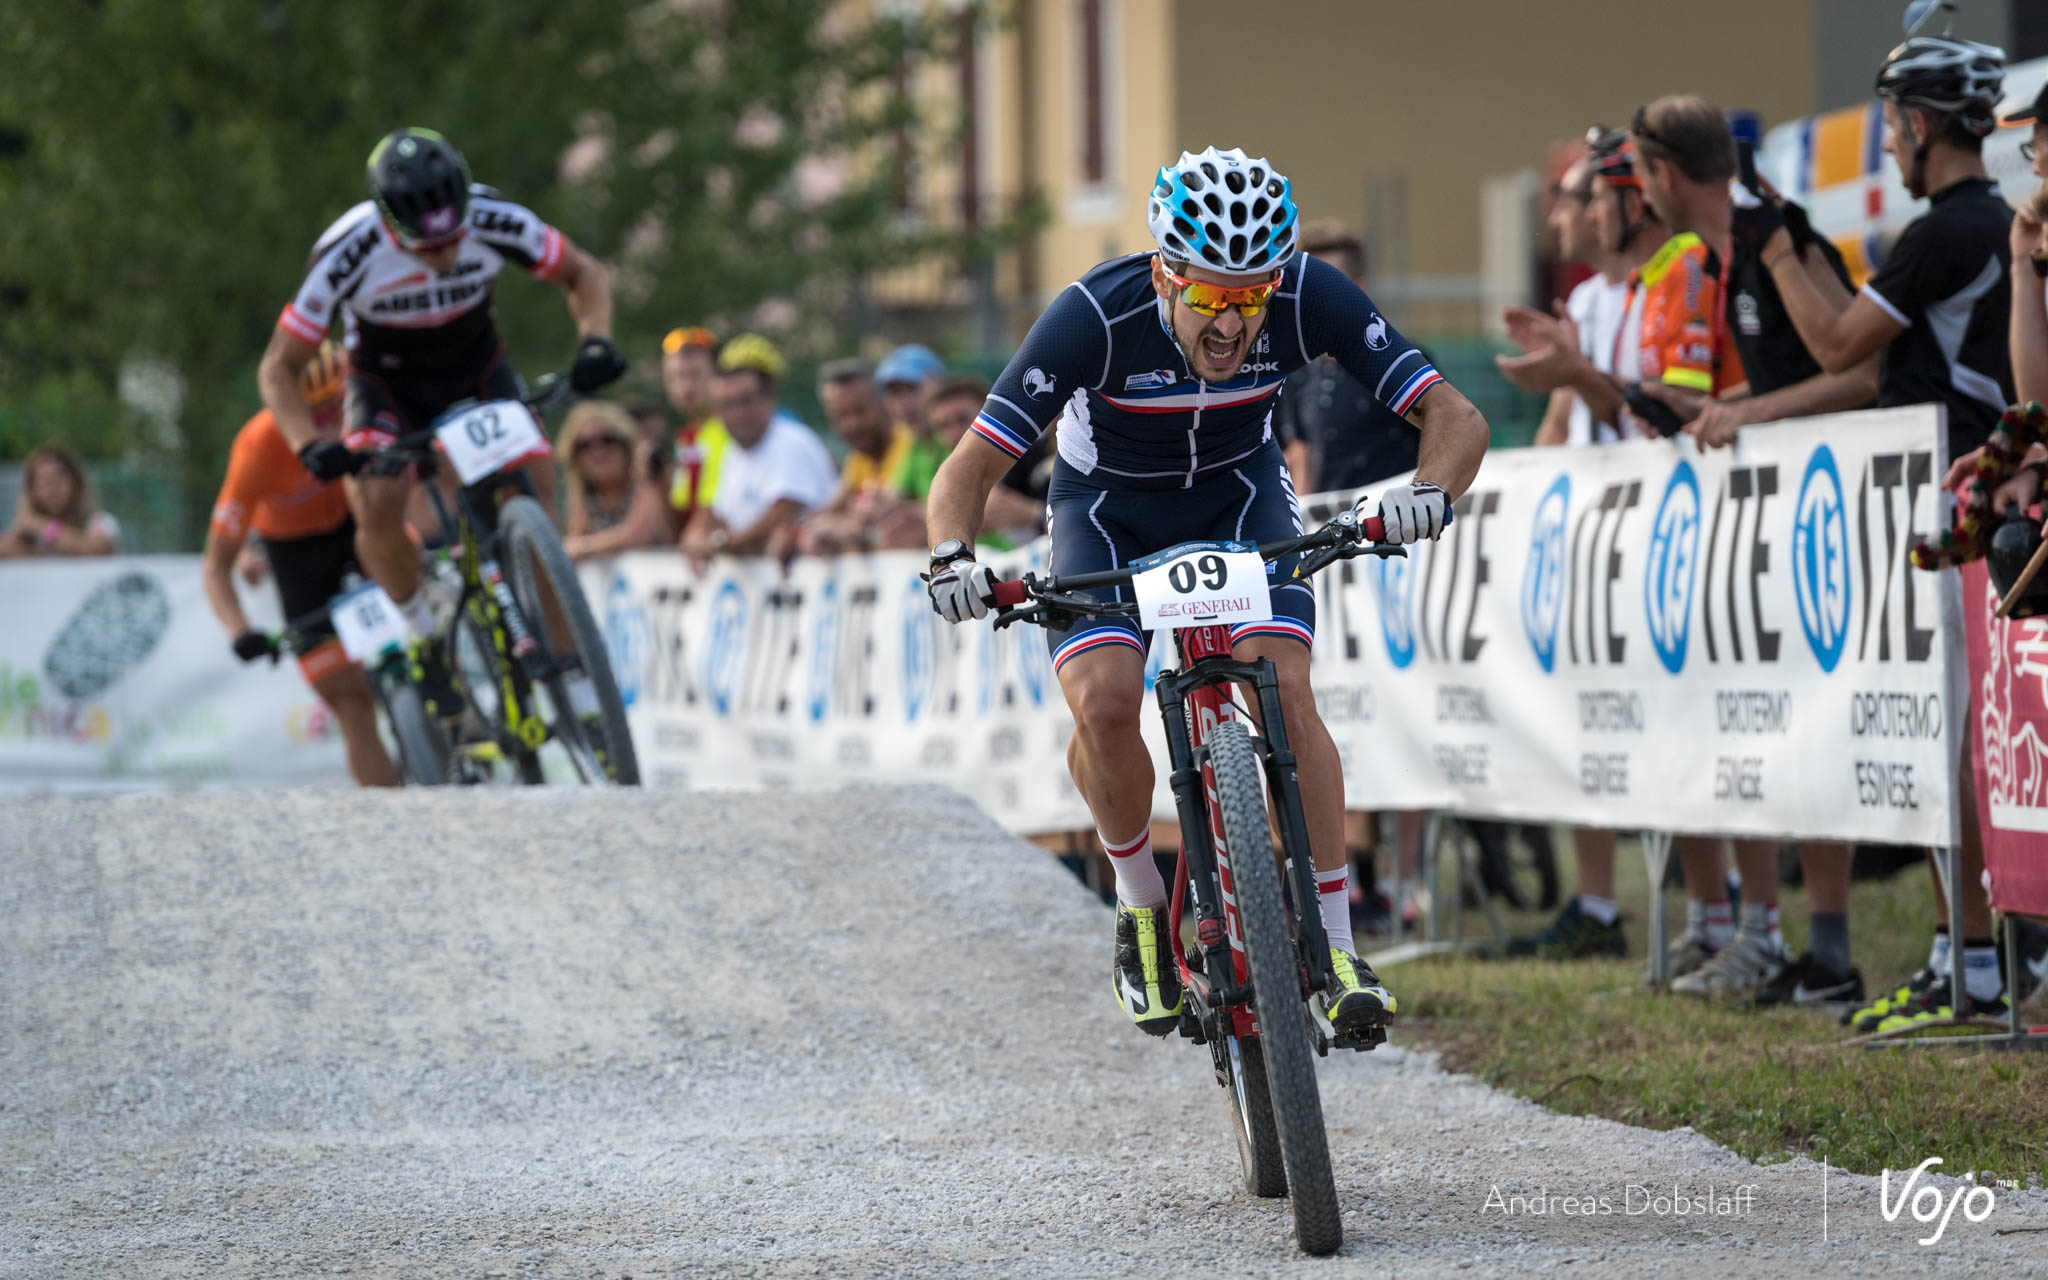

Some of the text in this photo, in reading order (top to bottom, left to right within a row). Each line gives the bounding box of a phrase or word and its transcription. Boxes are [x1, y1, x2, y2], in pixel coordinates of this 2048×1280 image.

[1237, 361, 1279, 374] OOK
[464, 405, 510, 450] 02
[1168, 554, 1228, 594] 09
[1569, 481, 1643, 664] ITE
[1703, 464, 1782, 663] ITE
[1857, 450, 1936, 662] ITE
[1181, 597, 1252, 615] GENERALI
[1851, 690, 1944, 739] IDROTERMO
[1855, 762, 1918, 809] ESINESE
